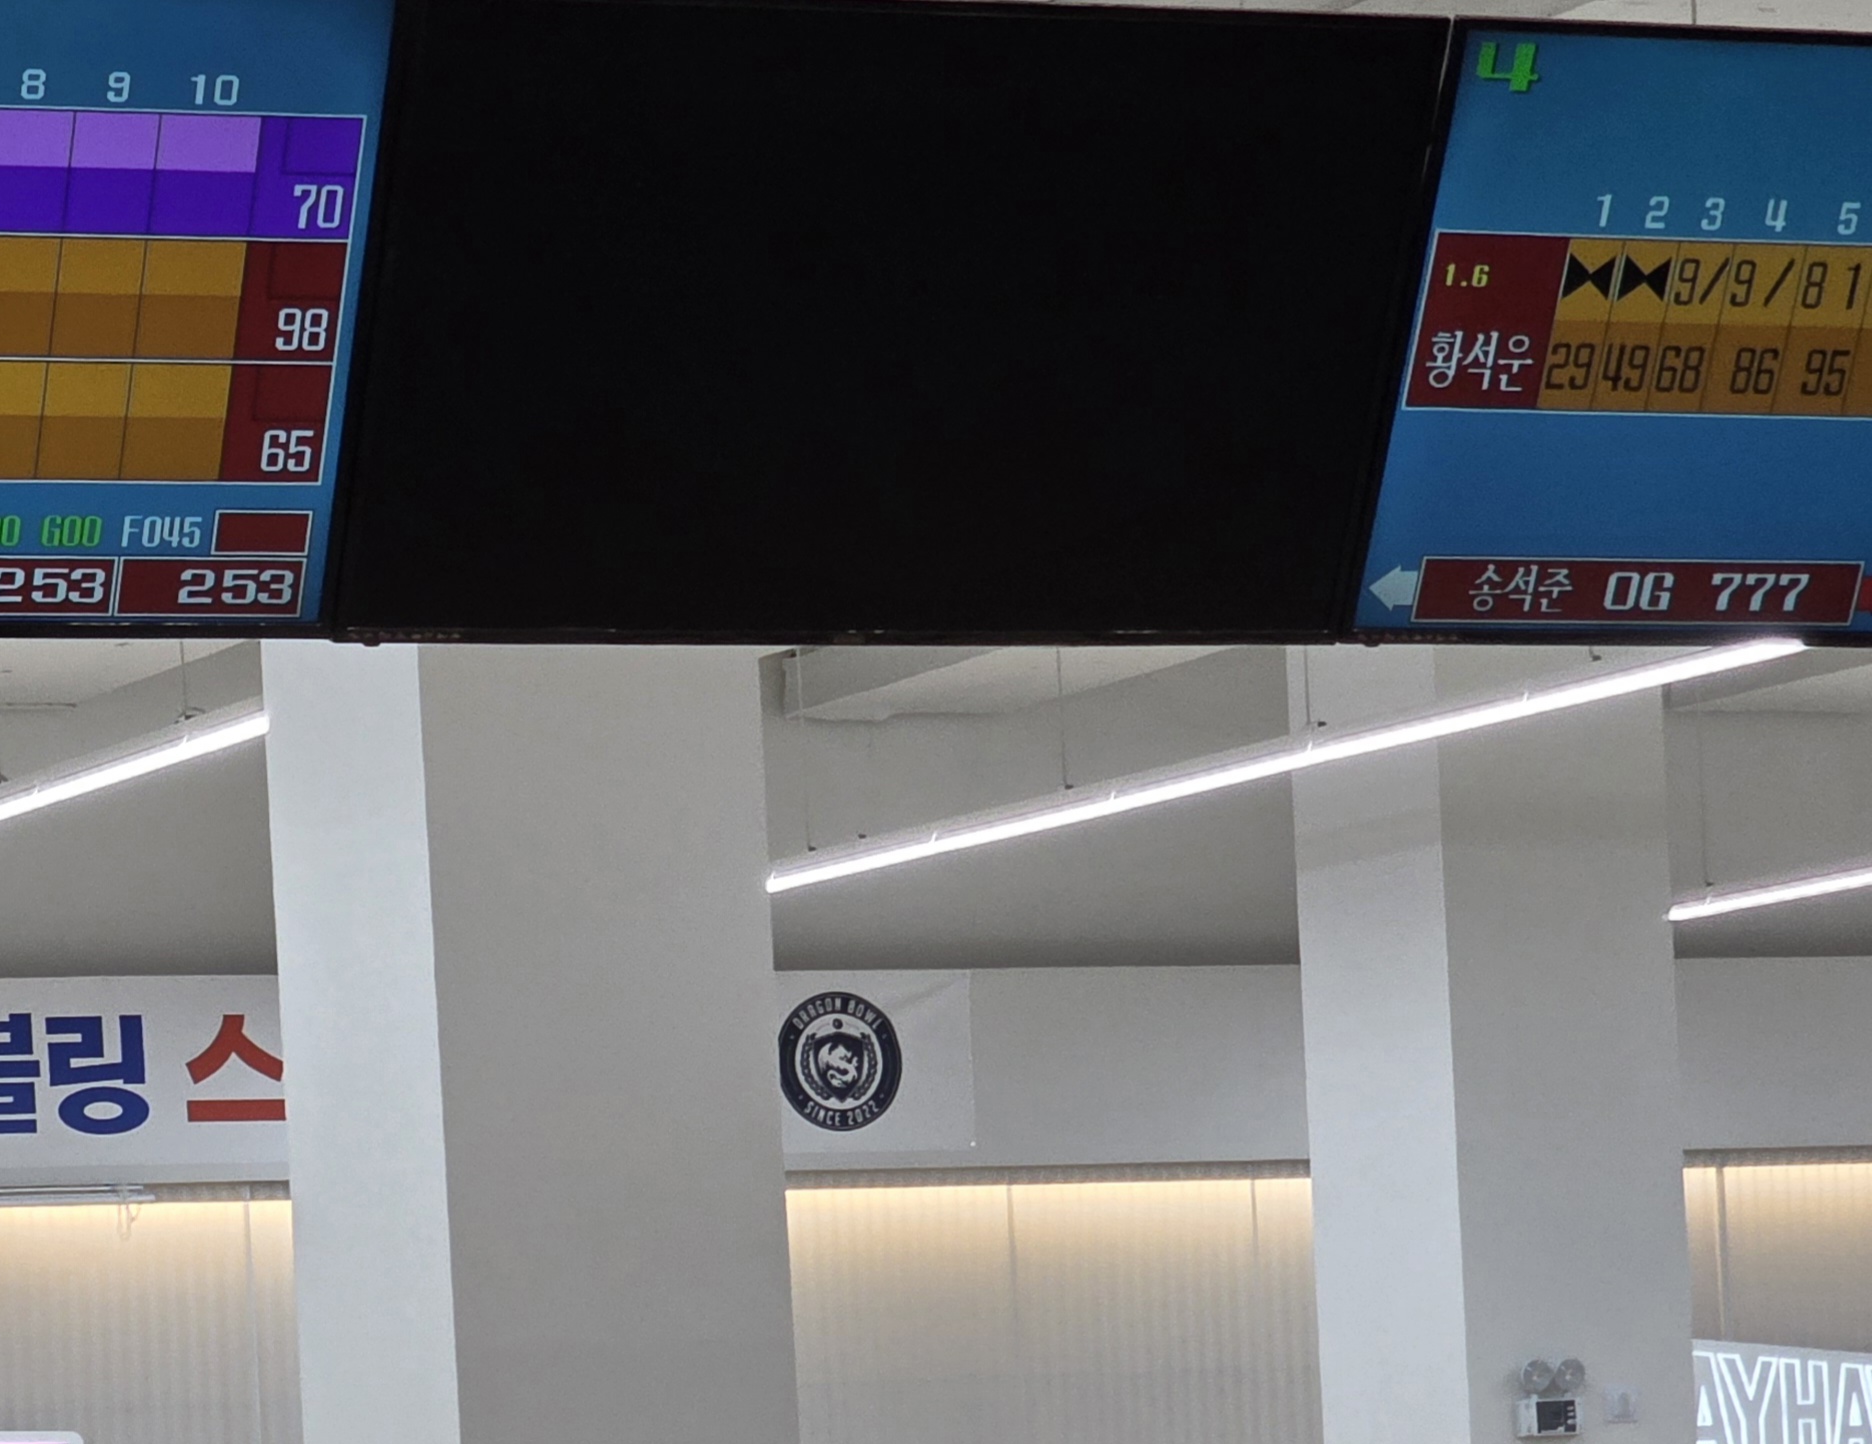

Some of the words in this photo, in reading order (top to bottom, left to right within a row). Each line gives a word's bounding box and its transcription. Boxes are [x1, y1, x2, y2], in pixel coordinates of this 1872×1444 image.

[20, 69, 47, 99] 8
[106, 71, 131, 102] 9
[191, 74, 240, 105] 10
[1476, 42, 1539, 93] 4
[293, 184, 344, 229] 70
[1597, 195, 1613, 227] 1
[1645, 196, 1670, 229] 2
[1700, 198, 1726, 230] 3
[1765, 199, 1788, 232] 4
[1837, 202, 1861, 235] 5
[1444, 264, 1489, 289] 1.6
[275, 308, 327, 351] 98
[1545, 343, 1596, 392] 29
[1602, 344, 1647, 393] 49
[1654, 345, 1706, 394] 68
[1729, 347, 1780, 396] 86
[1800, 348, 1851, 397] 95
[260, 429, 313, 473] 65
[121, 515, 203, 548] F045
[177, 569, 294, 604] 253
[1467, 563, 1573, 612] 송석준
[1710, 573, 1810, 612] 777
[791, 997, 842, 1030] DRAGON
[846, 999, 884, 1030] BOWL
[804, 1101, 841, 1126] SINCE
[847, 1101, 880, 1126] 2022
